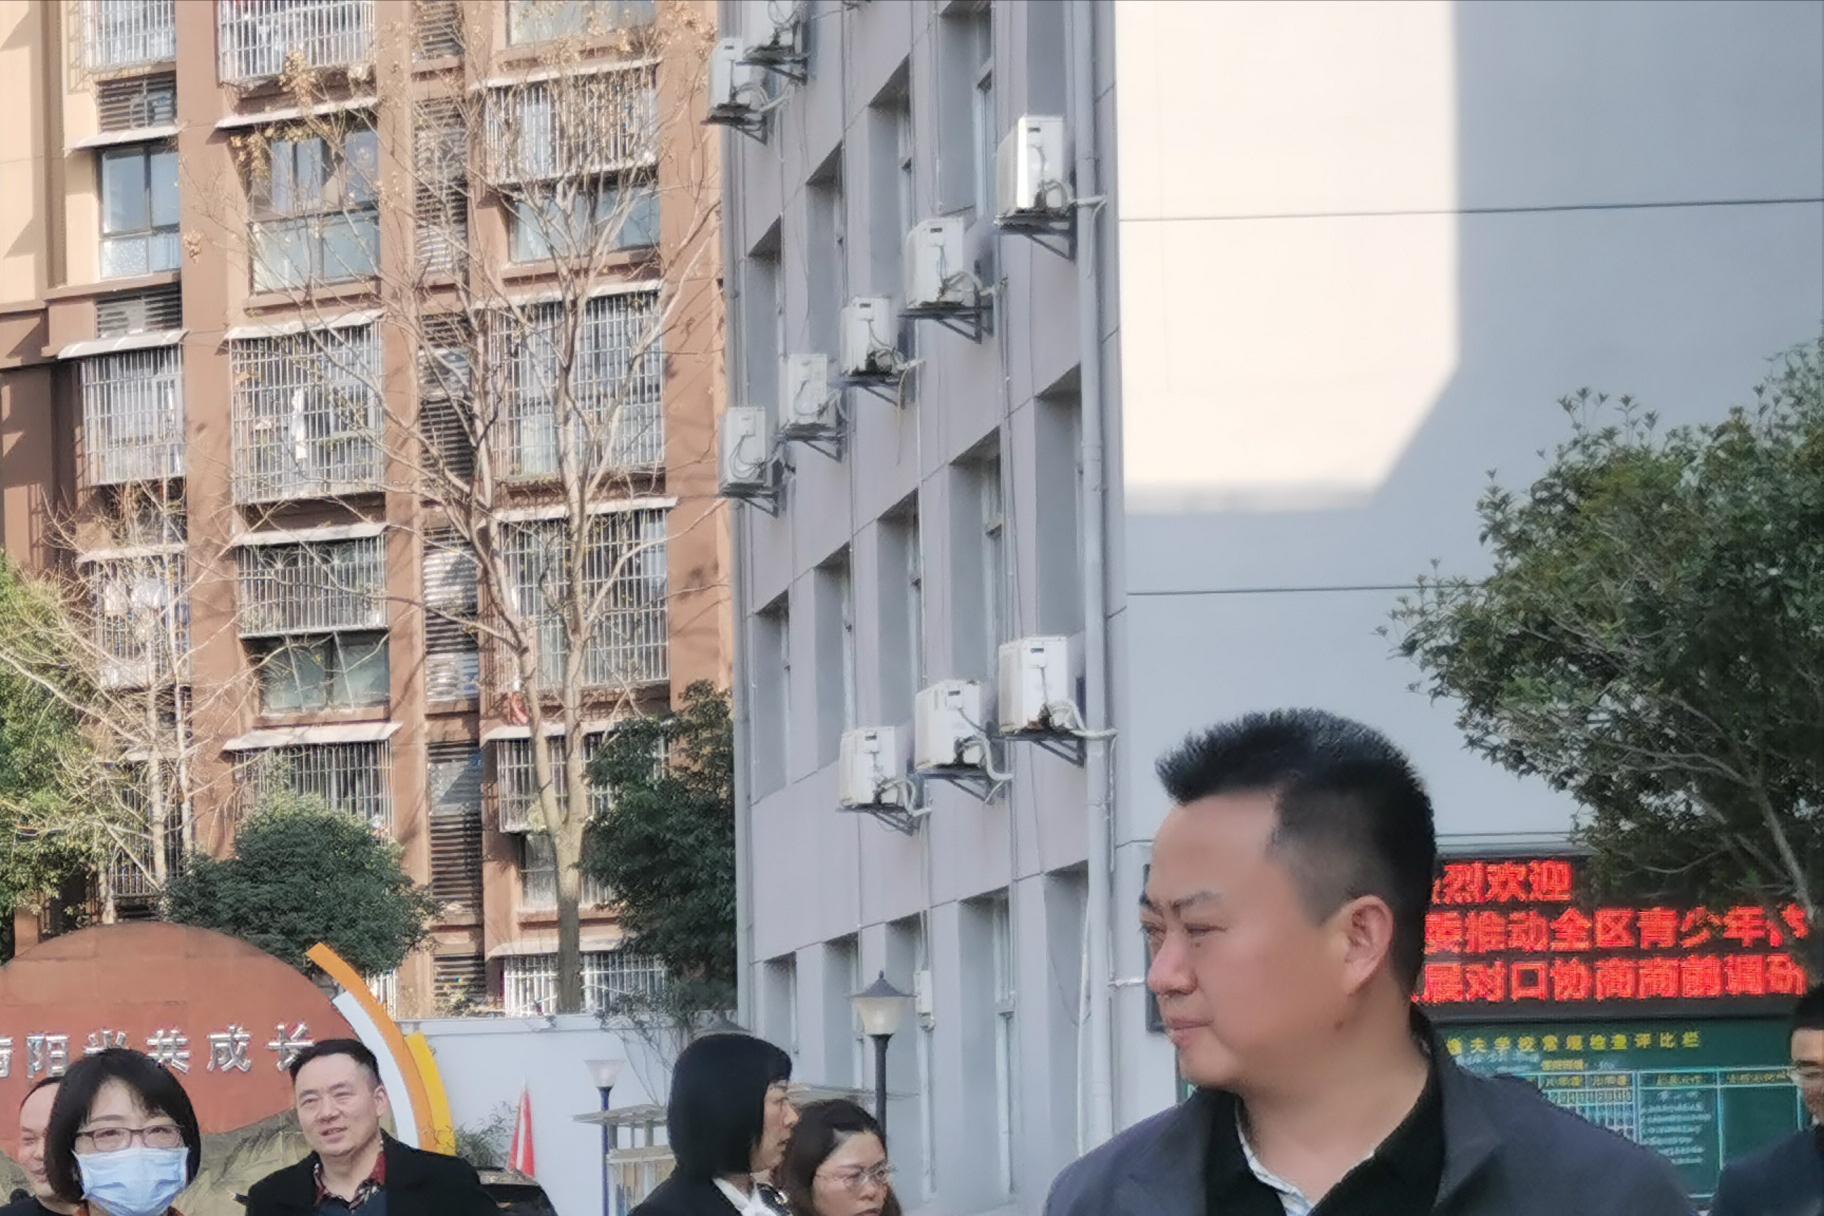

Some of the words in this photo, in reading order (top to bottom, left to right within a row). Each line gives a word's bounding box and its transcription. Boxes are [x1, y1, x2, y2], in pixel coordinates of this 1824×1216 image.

[1410, 953, 1808, 1004] 展对口协商商前调研
